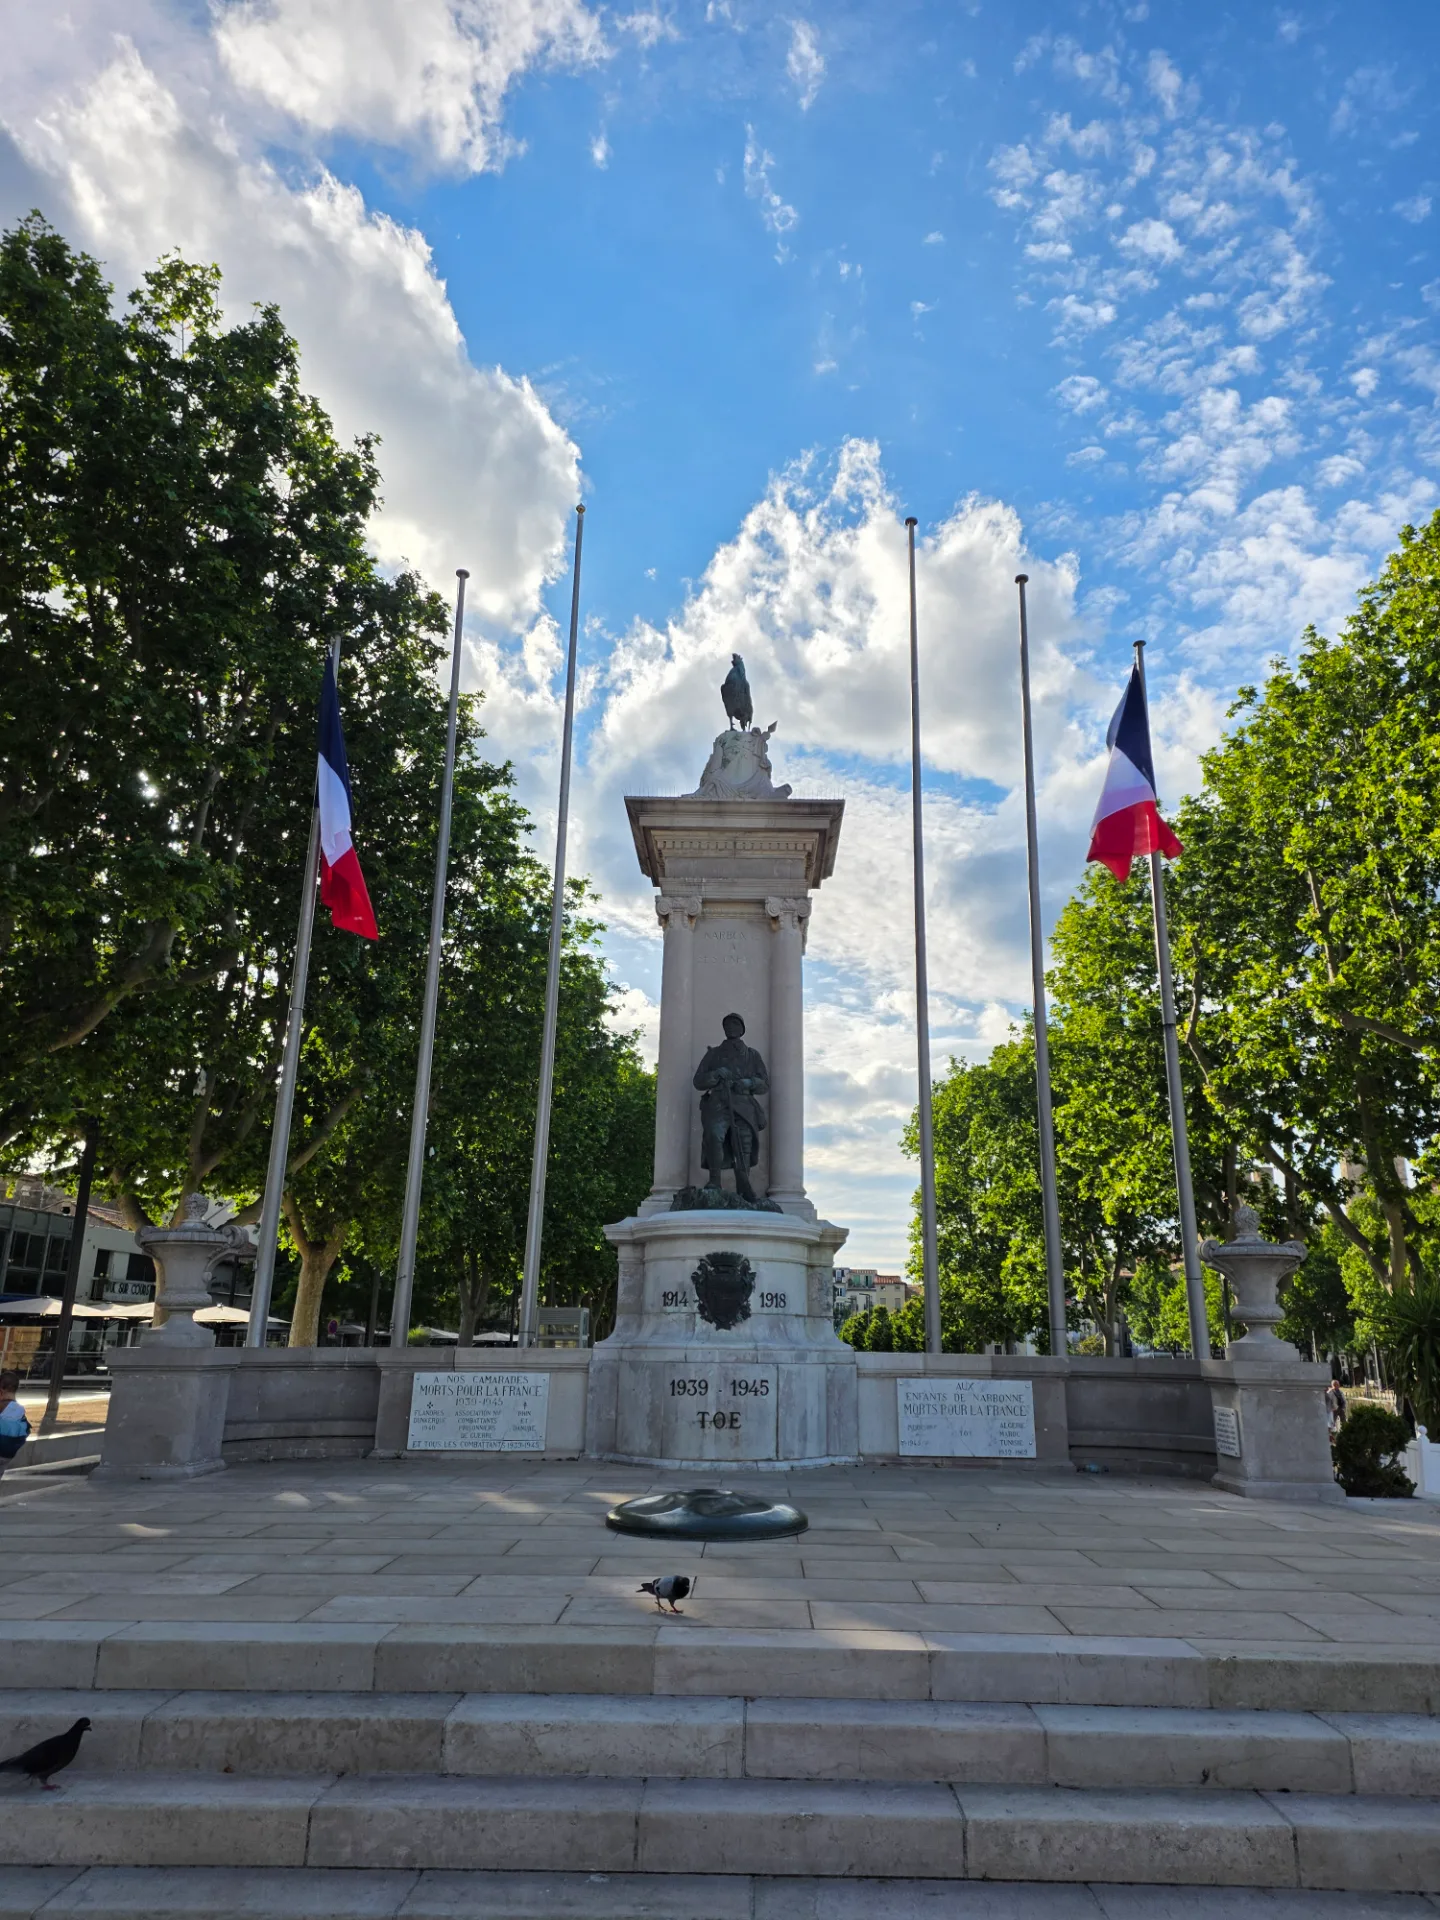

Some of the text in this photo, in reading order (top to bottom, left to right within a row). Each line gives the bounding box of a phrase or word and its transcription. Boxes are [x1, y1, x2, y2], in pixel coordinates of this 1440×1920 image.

[118, 1282, 129, 1294] SUR
[131, 1283, 150, 1296] COURS
[662, 1291, 689, 1307] 1914
[759, 1292, 787, 1308] 1918
[447, 1375, 465, 1383] NOS
[473, 1375, 529, 1384] CAMARADES
[420, 1385, 542, 1397] MORTS POUR LA FRANCE
[670, 1379, 708, 1396] 1939
[731, 1379, 769, 1396] 1945
[956, 1382, 975, 1391] AUX
[906, 1392, 1025, 1403] ENFANTS DE NARBONNE
[903, 1403, 1027, 1417] MORTS POUR LA FRANCE
[424, 1440, 441, 1448] TOUS
[443, 1440, 457, 1448] LES
[460, 1440, 505, 1449] COMBATTANTS
